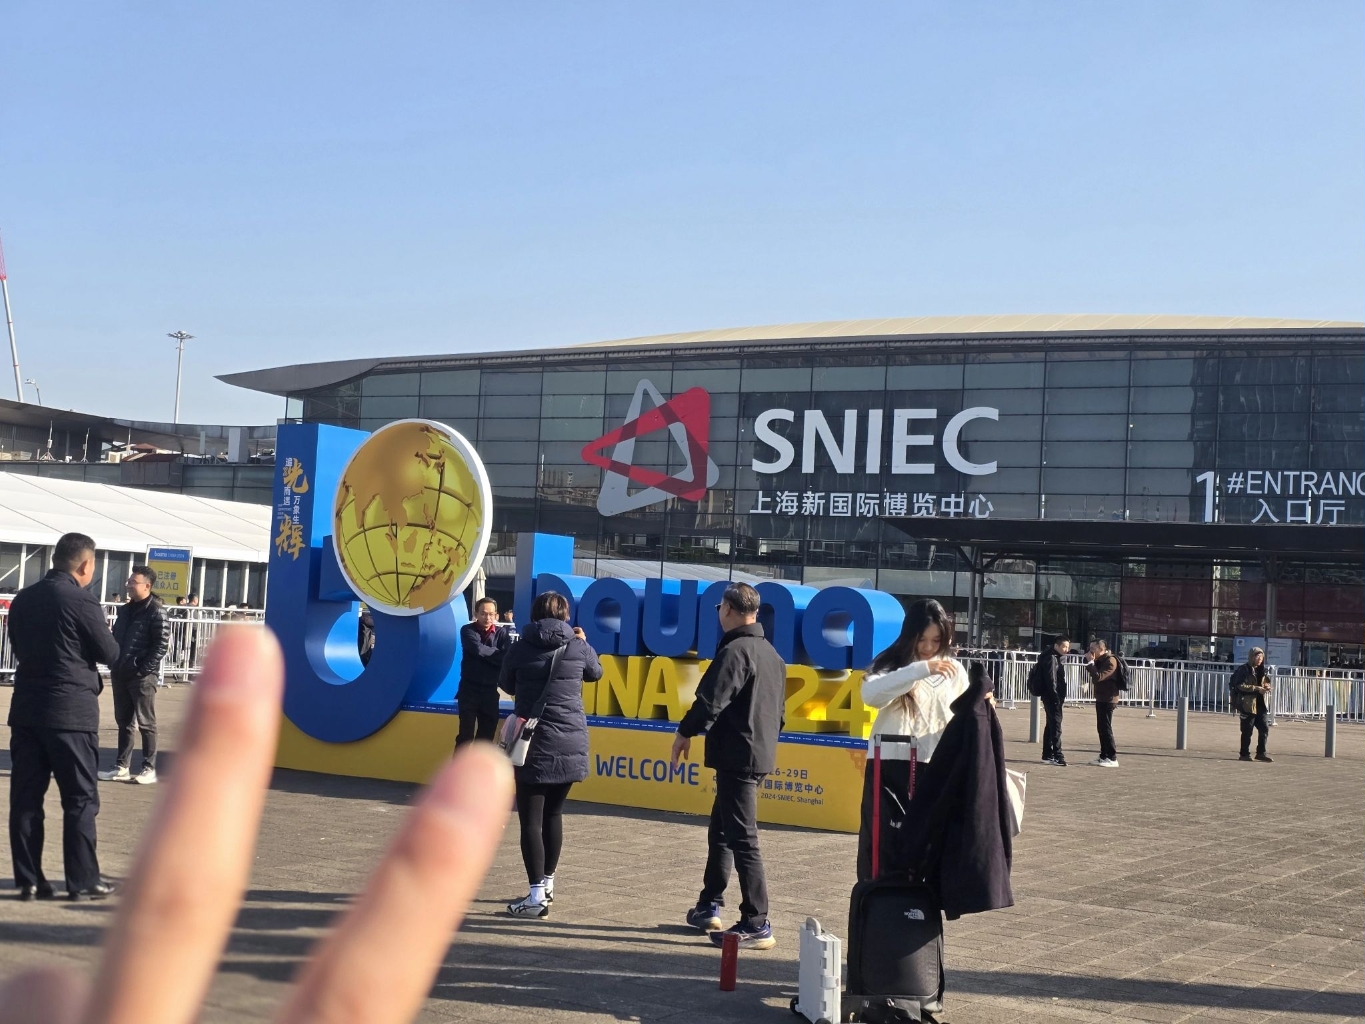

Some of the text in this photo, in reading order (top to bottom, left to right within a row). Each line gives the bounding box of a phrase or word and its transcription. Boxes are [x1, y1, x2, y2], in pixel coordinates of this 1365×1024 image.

[752, 406, 999, 476] SNIEC
[749, 490, 994, 518] 上海新国际博览中心
[1251, 498, 1346, 525] 入口厅
[596, 754, 700, 787] WELCOME
